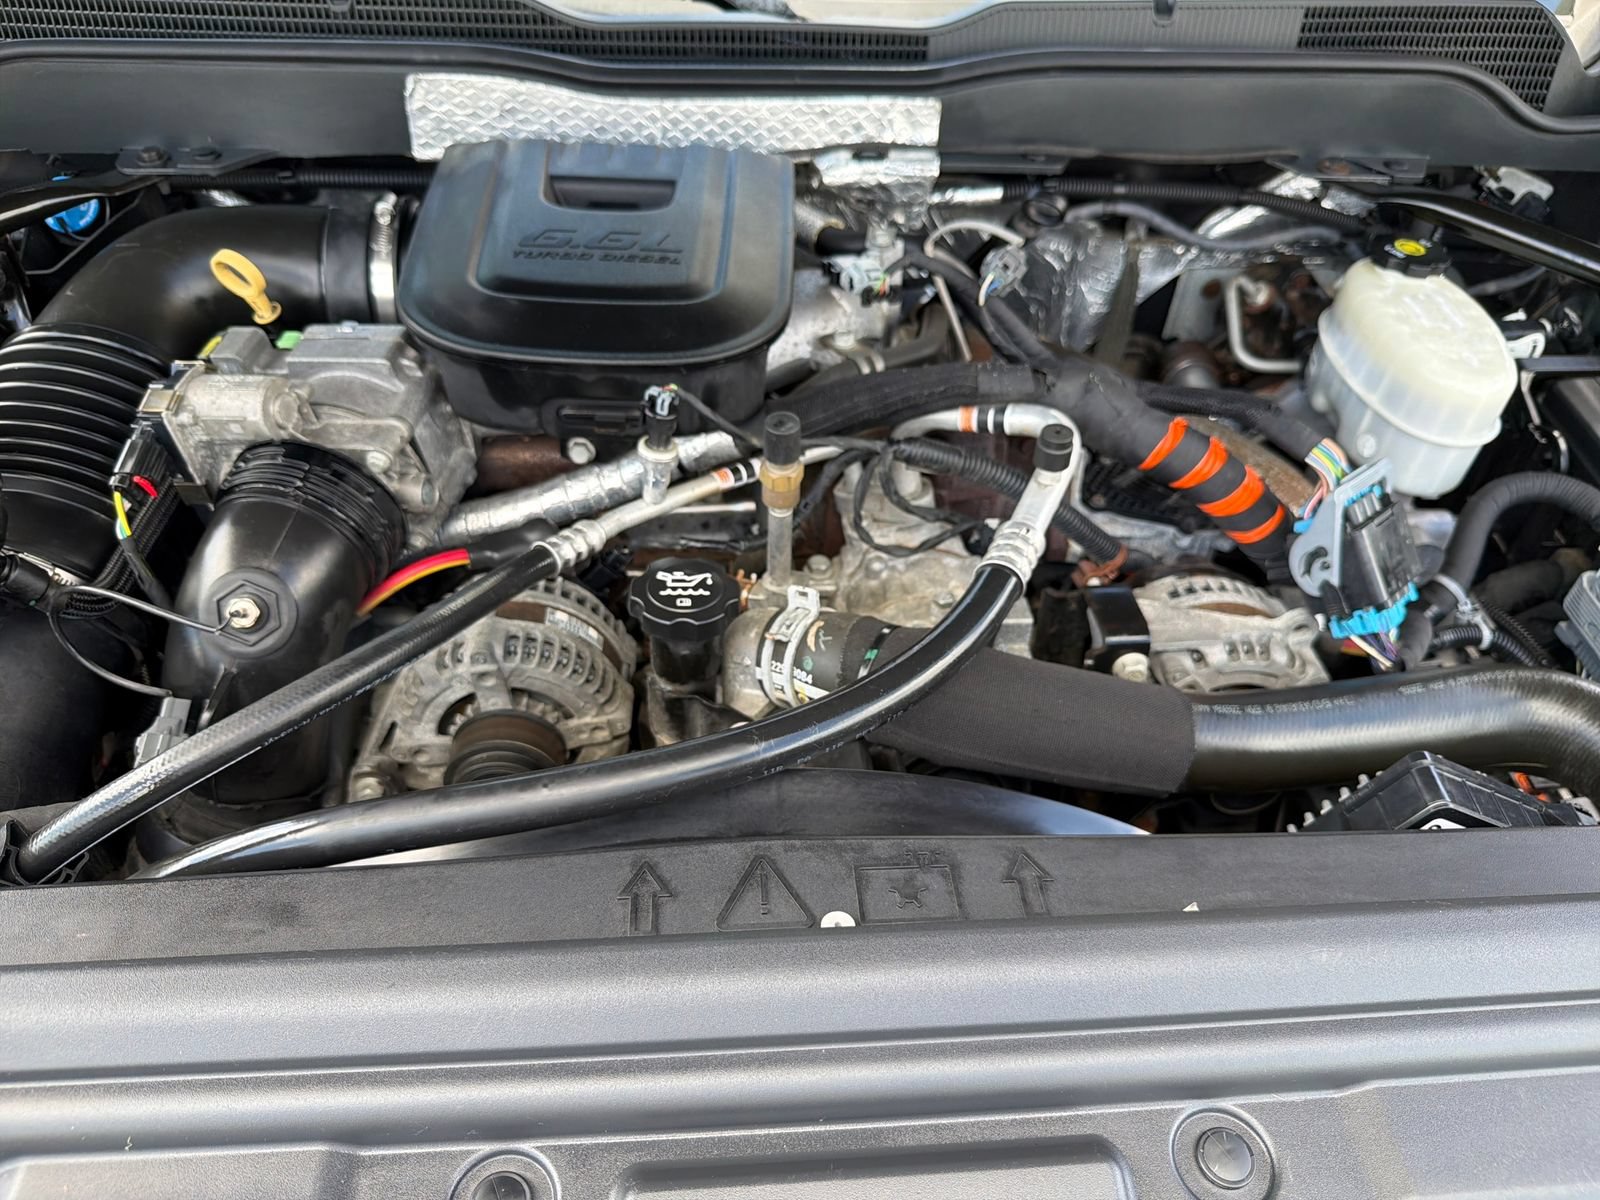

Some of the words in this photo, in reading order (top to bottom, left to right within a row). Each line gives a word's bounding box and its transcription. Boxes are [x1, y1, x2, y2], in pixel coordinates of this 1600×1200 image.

[518, 229, 683, 254] 6.6L
[511, 249, 594, 261] TURBO
[598, 253, 681, 266] DIESEL
